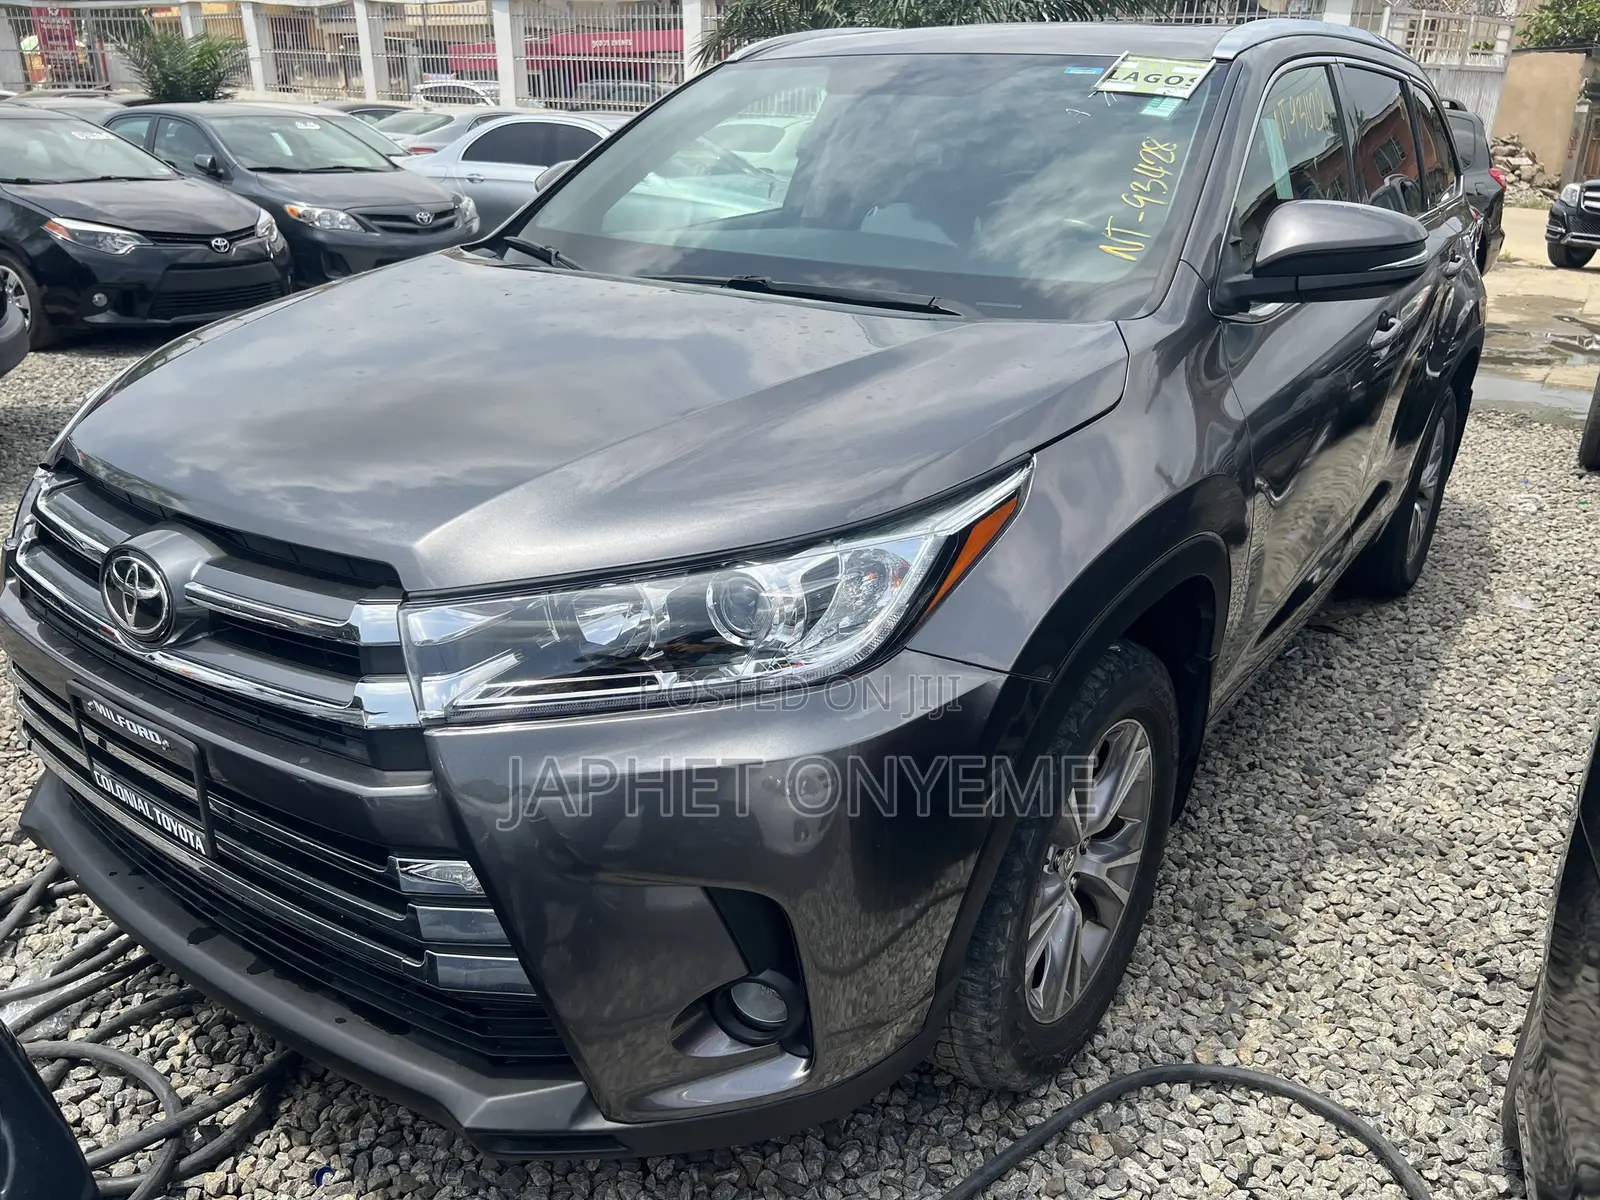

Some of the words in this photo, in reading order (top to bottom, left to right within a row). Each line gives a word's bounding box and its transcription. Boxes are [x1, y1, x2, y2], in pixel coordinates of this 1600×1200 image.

[92, 700, 162, 745] MILFORD
[93, 770, 154, 820] COLONIAL
[153, 808, 207, 855] TOYOTA
